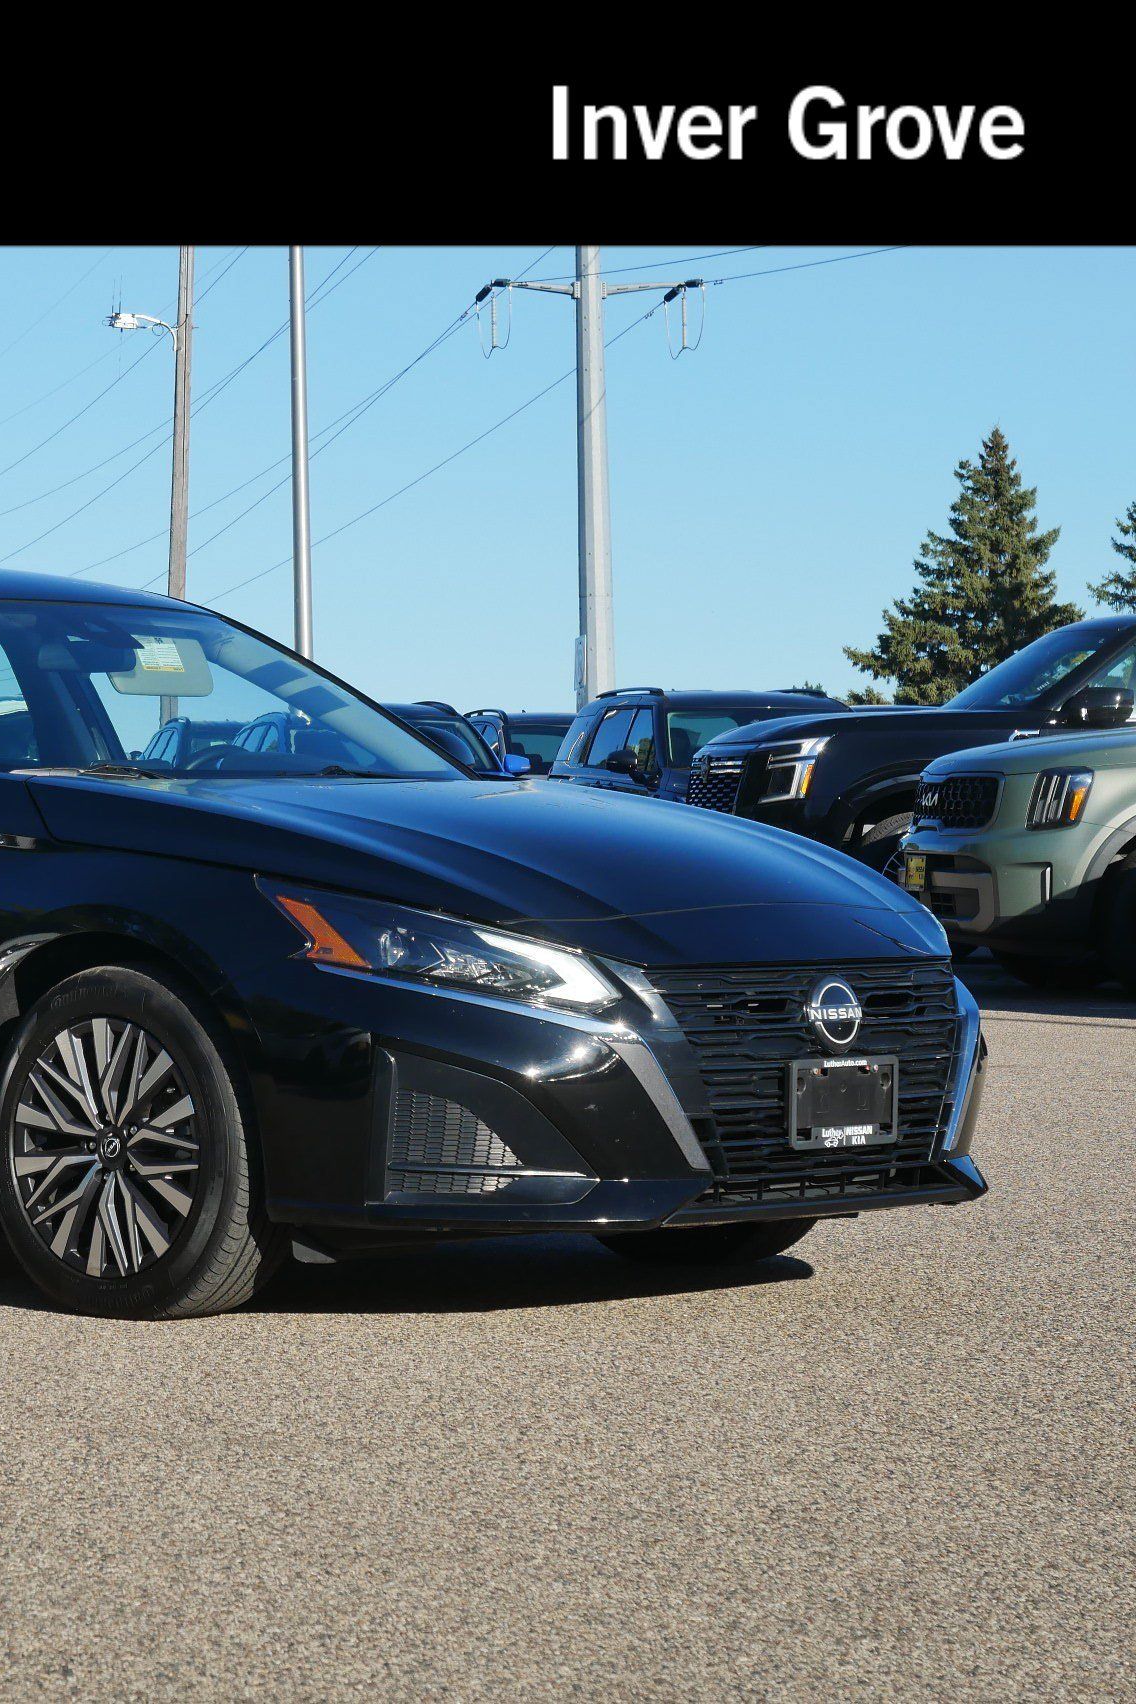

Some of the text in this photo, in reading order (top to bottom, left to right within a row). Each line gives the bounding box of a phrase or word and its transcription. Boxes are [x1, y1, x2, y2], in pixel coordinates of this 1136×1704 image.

[810, 1007, 863, 1020] NISSAN
[845, 1125, 873, 1135] NISSAN
[851, 1135, 866, 1145] KIA
